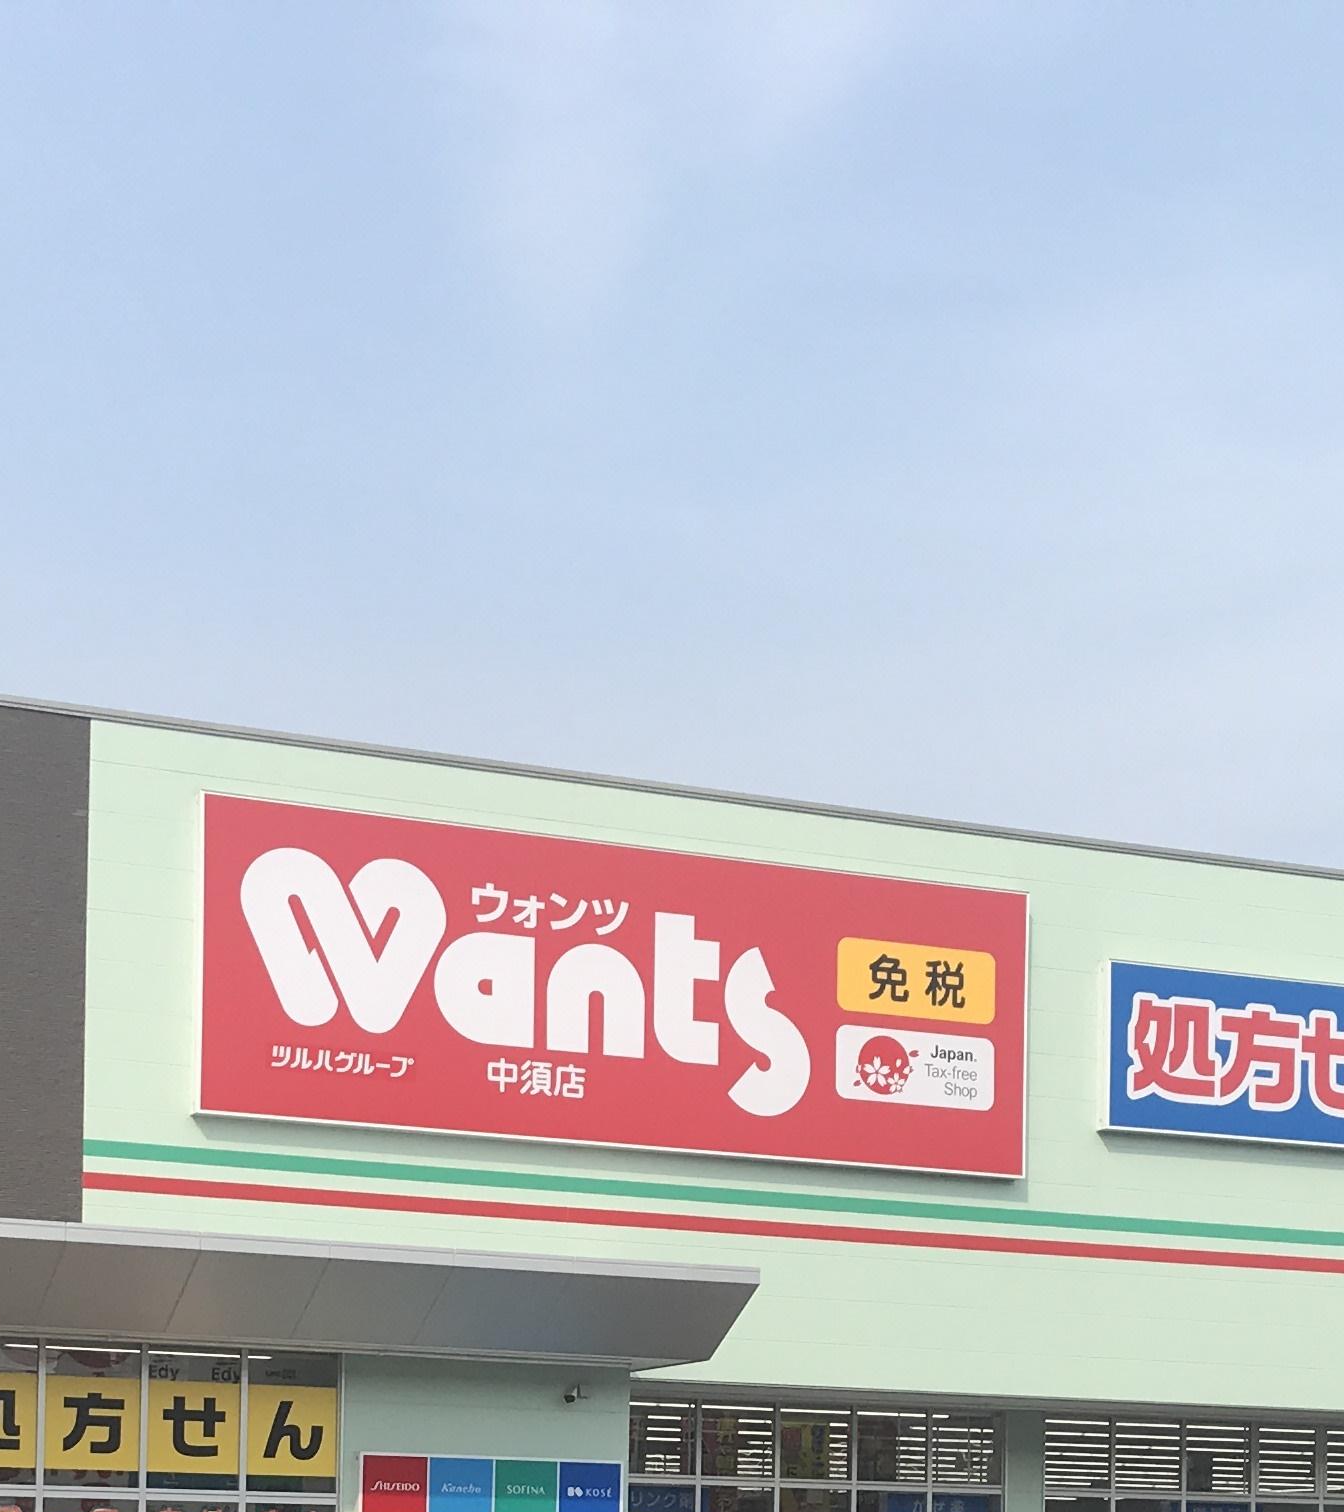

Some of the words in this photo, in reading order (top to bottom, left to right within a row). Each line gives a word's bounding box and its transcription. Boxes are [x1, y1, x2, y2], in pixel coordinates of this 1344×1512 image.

[470, 883, 630, 936] ウォンツ
[239, 846, 812, 1118] Wants
[869, 953, 966, 1009] 免税
[270, 1044, 417, 1079] ツルハグループ
[930, 1045, 978, 1063] Japan.
[487, 1058, 587, 1100] 中須店
[924, 1063, 978, 1082] Tax-free
[944, 1082, 978, 1100] Shop
[370, 1480, 420, 1492] SHISEIDO
[440, 1483, 482, 1495] Kanebo
[507, 1485, 546, 1495] SOFINA
